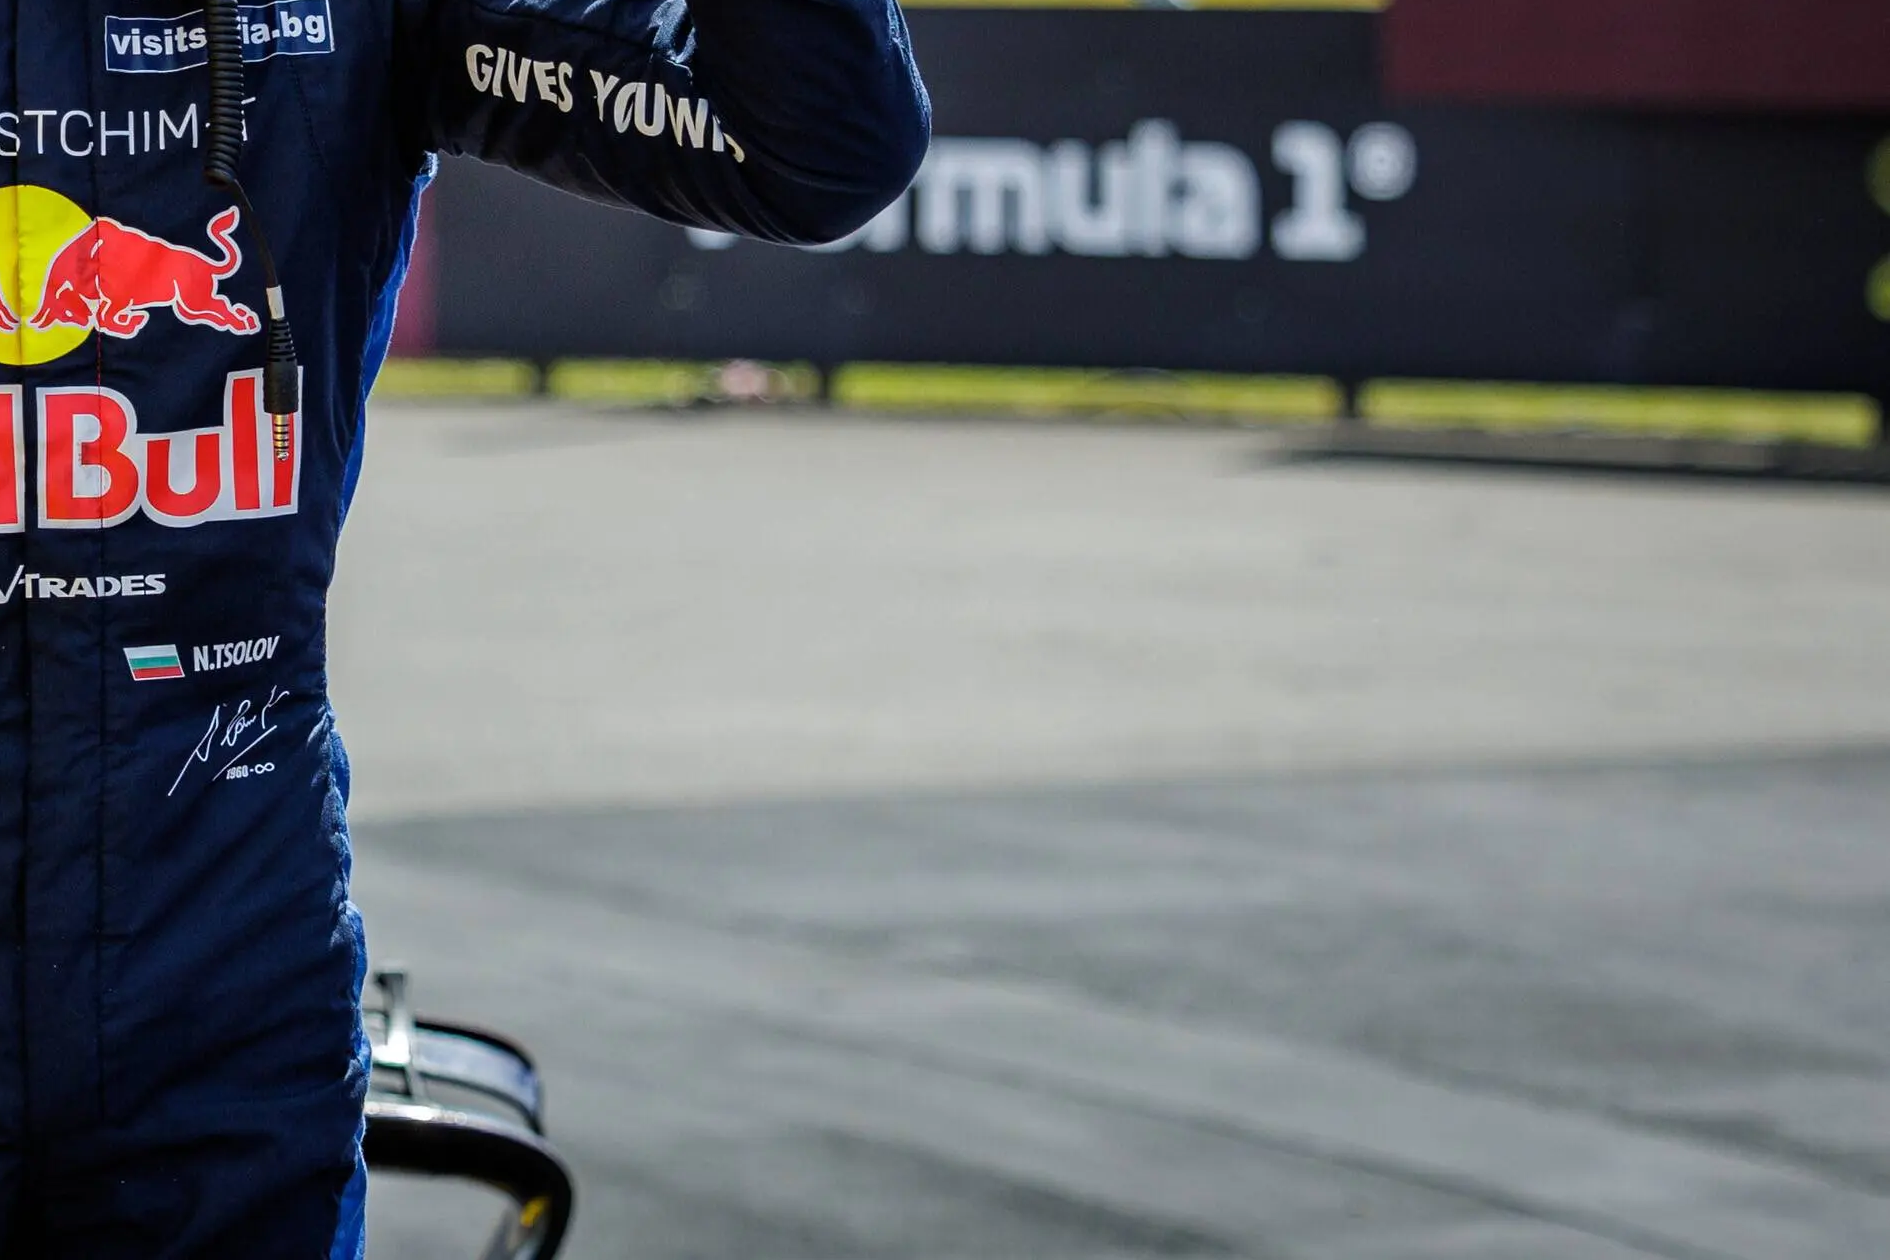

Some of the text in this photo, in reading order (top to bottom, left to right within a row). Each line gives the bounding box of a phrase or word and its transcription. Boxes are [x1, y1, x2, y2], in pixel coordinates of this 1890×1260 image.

[110, 11, 326, 56] visitsia.bg
[466, 43, 574, 112] GIVES
[590, 69, 666, 137] YOU
[686, 118, 1263, 261] mula
[37, 366, 303, 529] Bull
[193, 635, 280, 672] N.TSOLOV
